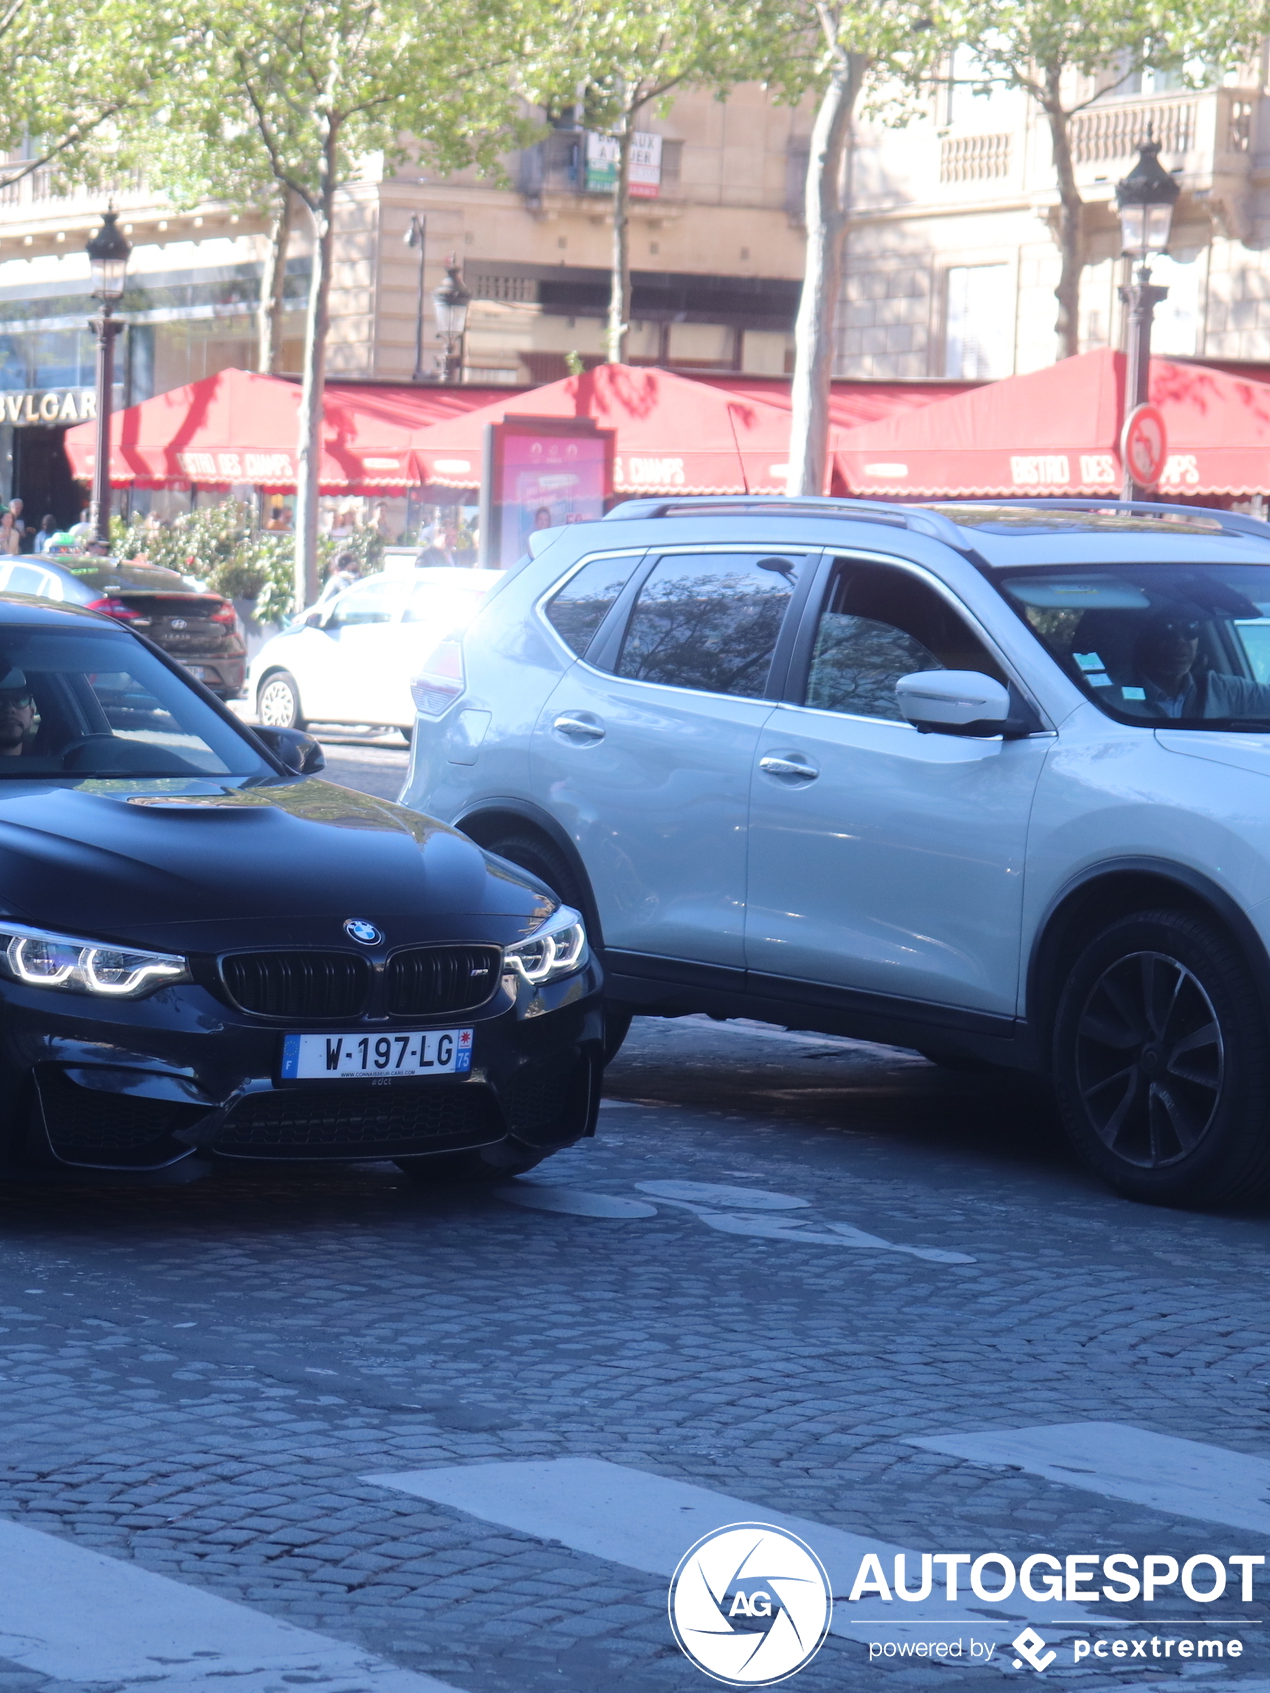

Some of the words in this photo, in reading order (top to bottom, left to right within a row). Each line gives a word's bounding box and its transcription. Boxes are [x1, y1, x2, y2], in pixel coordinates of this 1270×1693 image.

[218, 453, 242, 475] DES
[245, 454, 294, 476] CHAMPS
[630, 457, 685, 484] CHAMPS
[1009, 454, 1070, 484] BISTRO
[1079, 454, 1116, 483] DES
[326, 1033, 454, 1071] W-197-LG
[457, 1053, 470, 1068] 75
[285, 1060, 293, 1070] F
